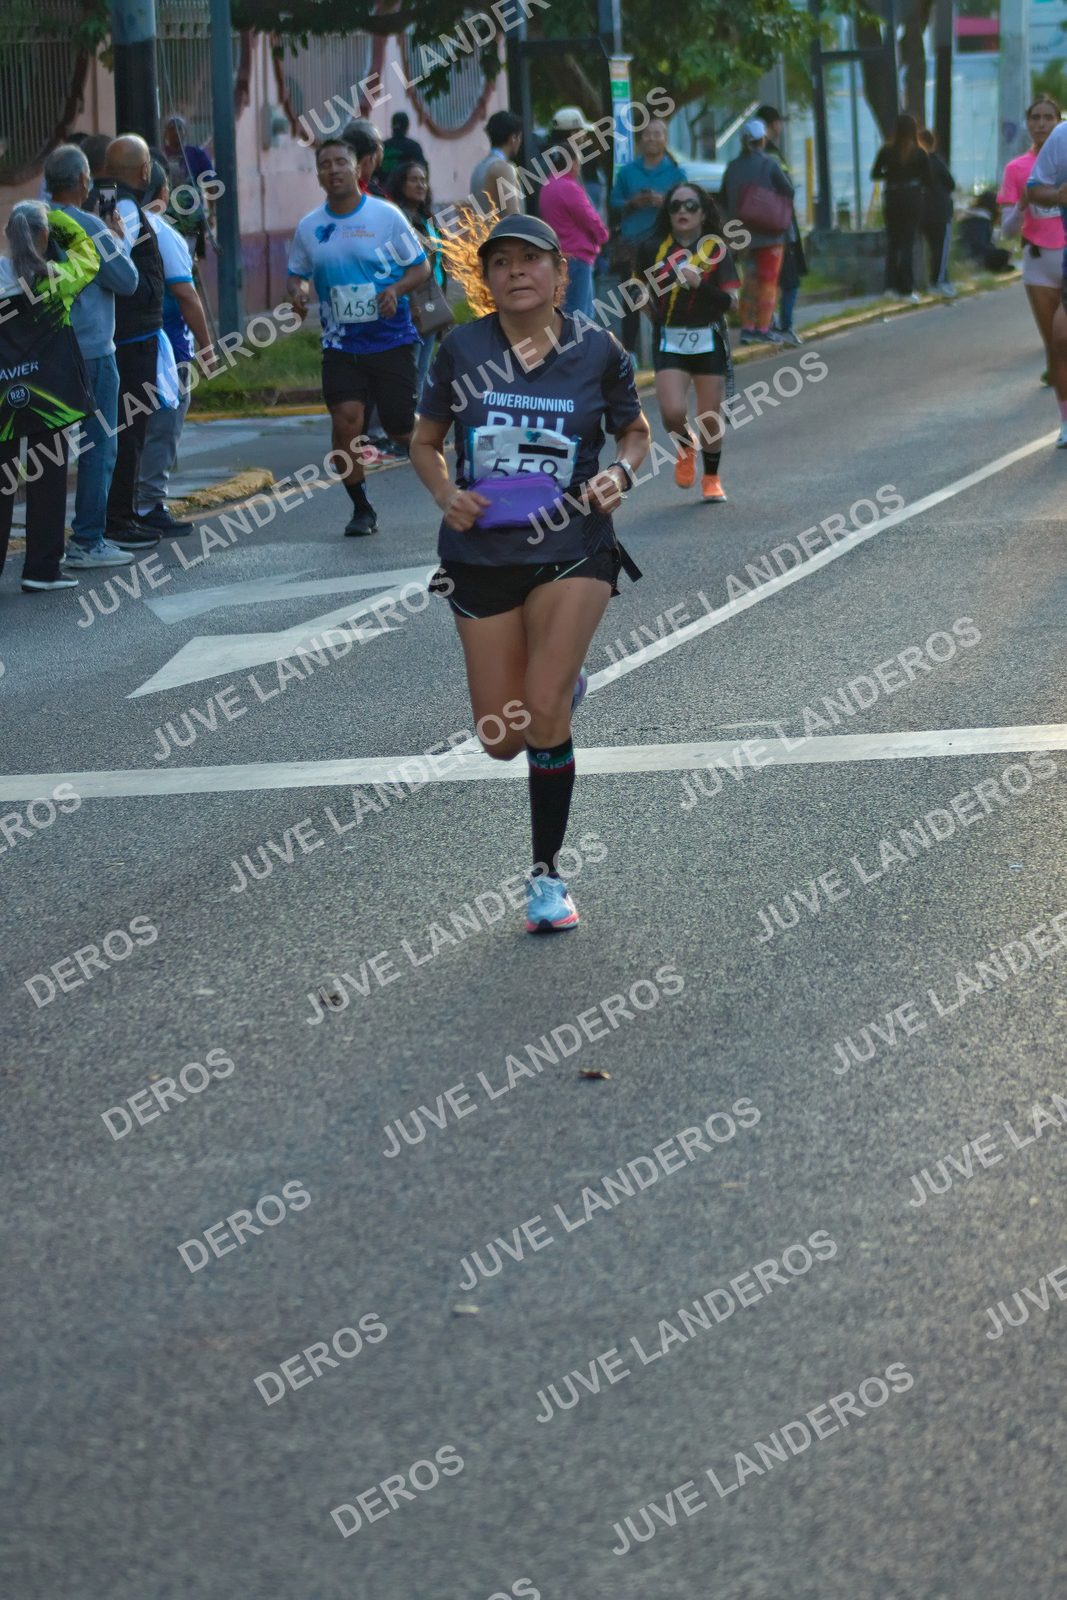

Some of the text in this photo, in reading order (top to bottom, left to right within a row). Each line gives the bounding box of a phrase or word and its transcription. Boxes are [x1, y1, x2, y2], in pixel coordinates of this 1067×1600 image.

[333, 300, 376, 318] 1455
[676, 332, 700, 349] 79
[482, 390, 575, 413] TOWERRUNNING
